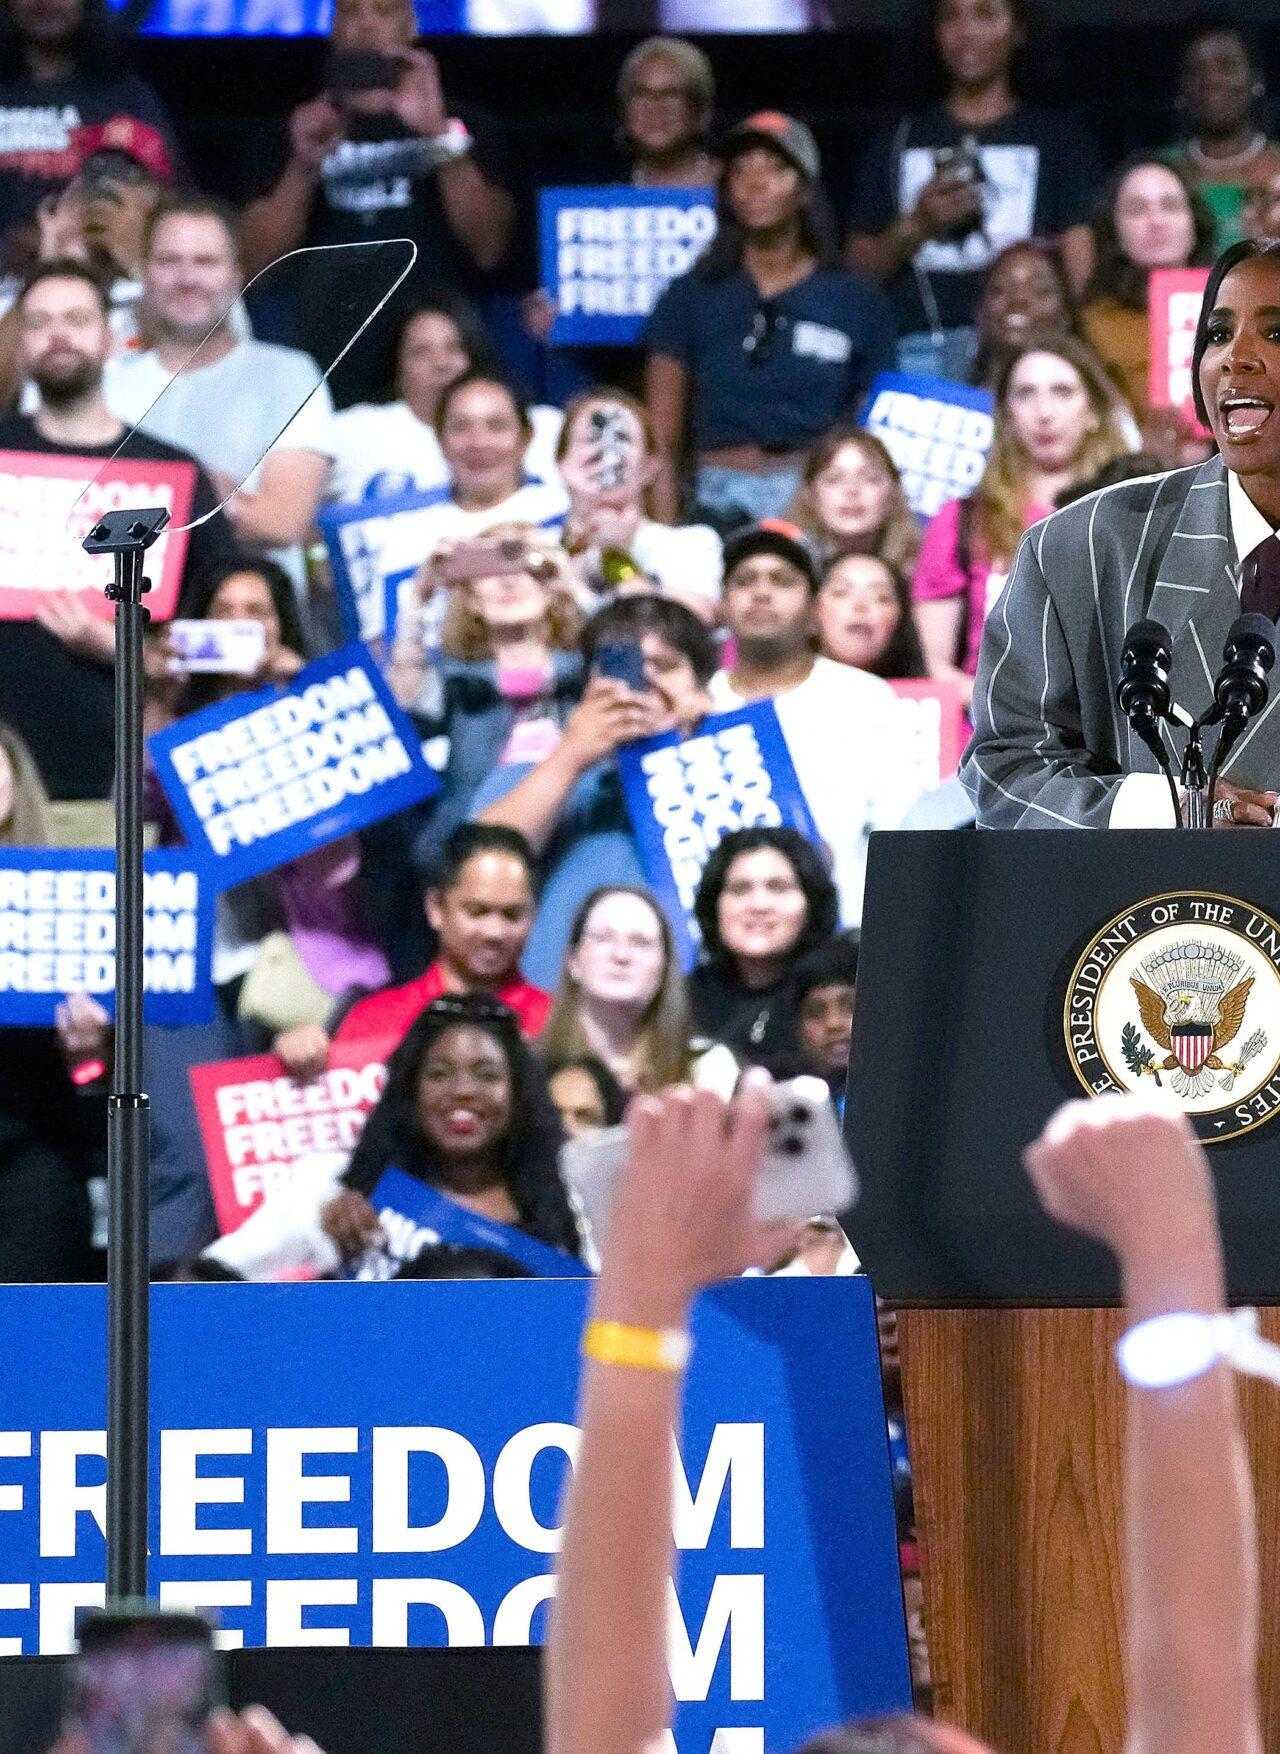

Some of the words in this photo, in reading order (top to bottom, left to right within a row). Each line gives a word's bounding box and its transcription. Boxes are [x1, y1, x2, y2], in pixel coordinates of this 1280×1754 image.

[170, 666, 376, 786] FREEDOM
[187, 700, 396, 820] FREEDOM
[202, 734, 413, 857] FREEDOM
[1071, 915, 1139, 1064] PRESIDENT
[1150, 903, 1180, 924] OF
[1190, 902, 1234, 925] THE
